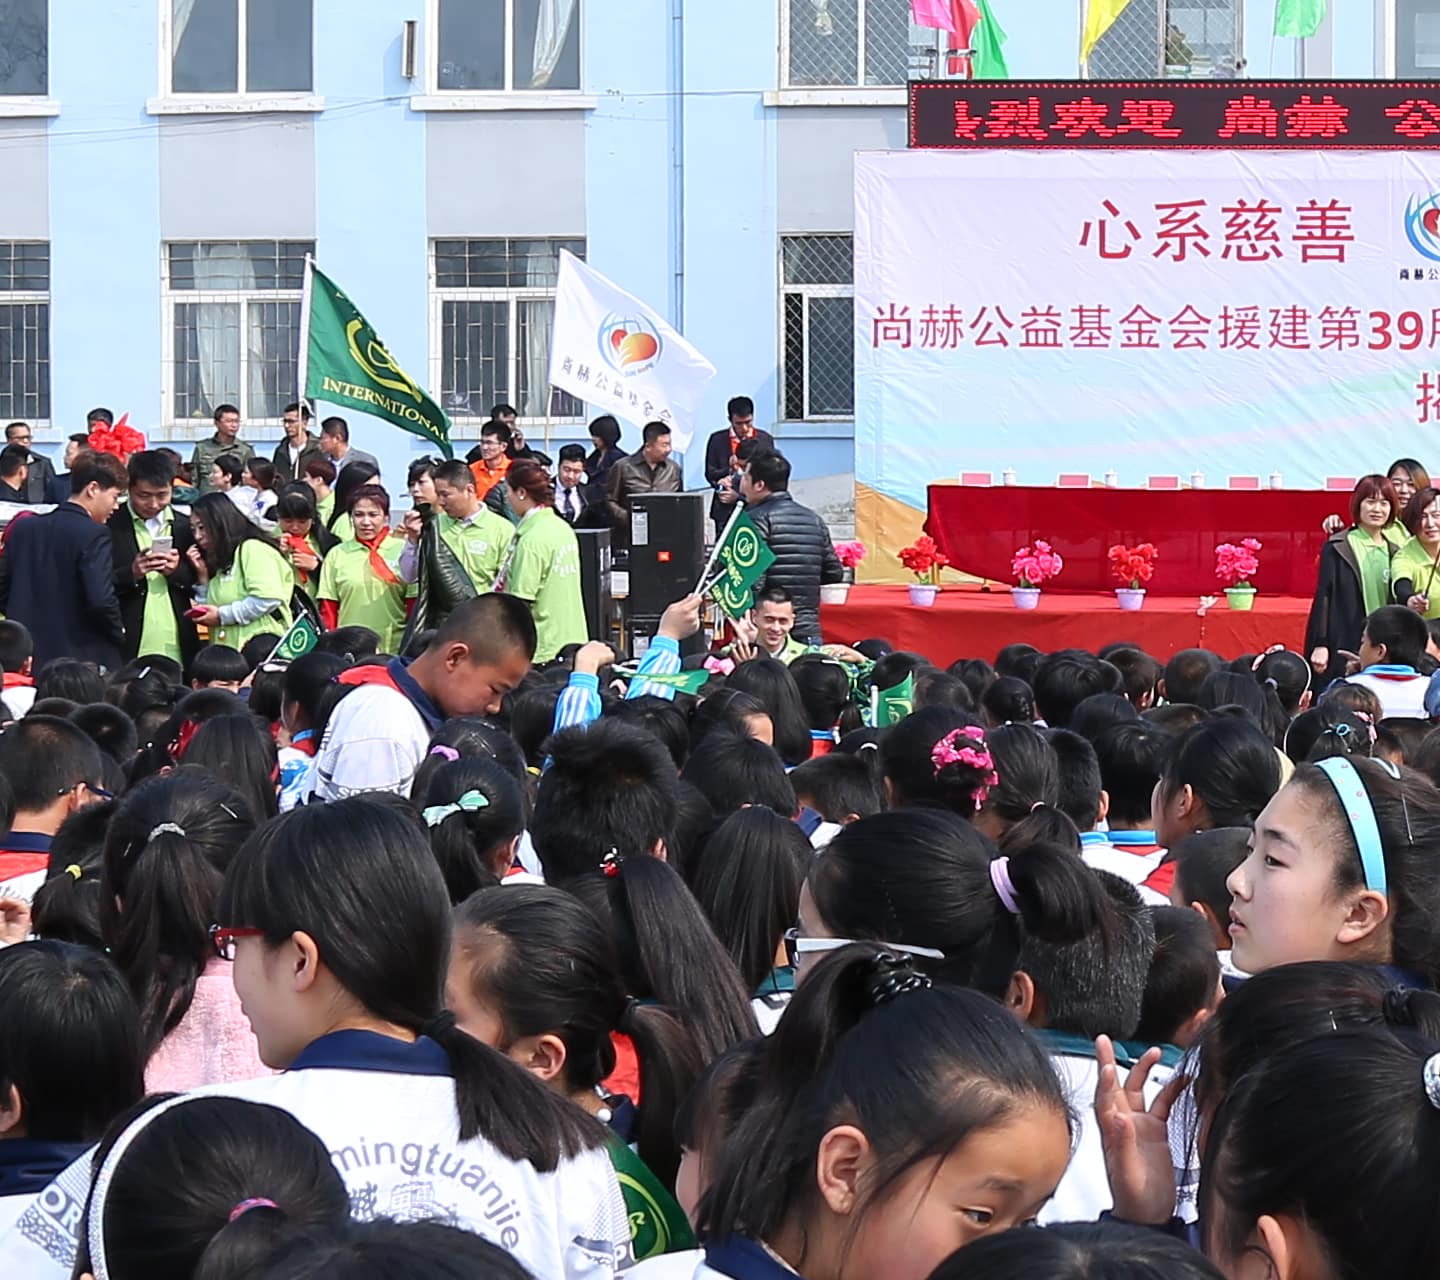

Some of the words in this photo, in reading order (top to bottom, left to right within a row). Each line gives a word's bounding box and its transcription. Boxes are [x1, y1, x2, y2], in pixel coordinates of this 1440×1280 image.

[1079, 198, 1355, 264] 心系慈善
[323, 376, 447, 444] INTERNATIONAL
[330, 1138, 521, 1249] mingtuanjie
